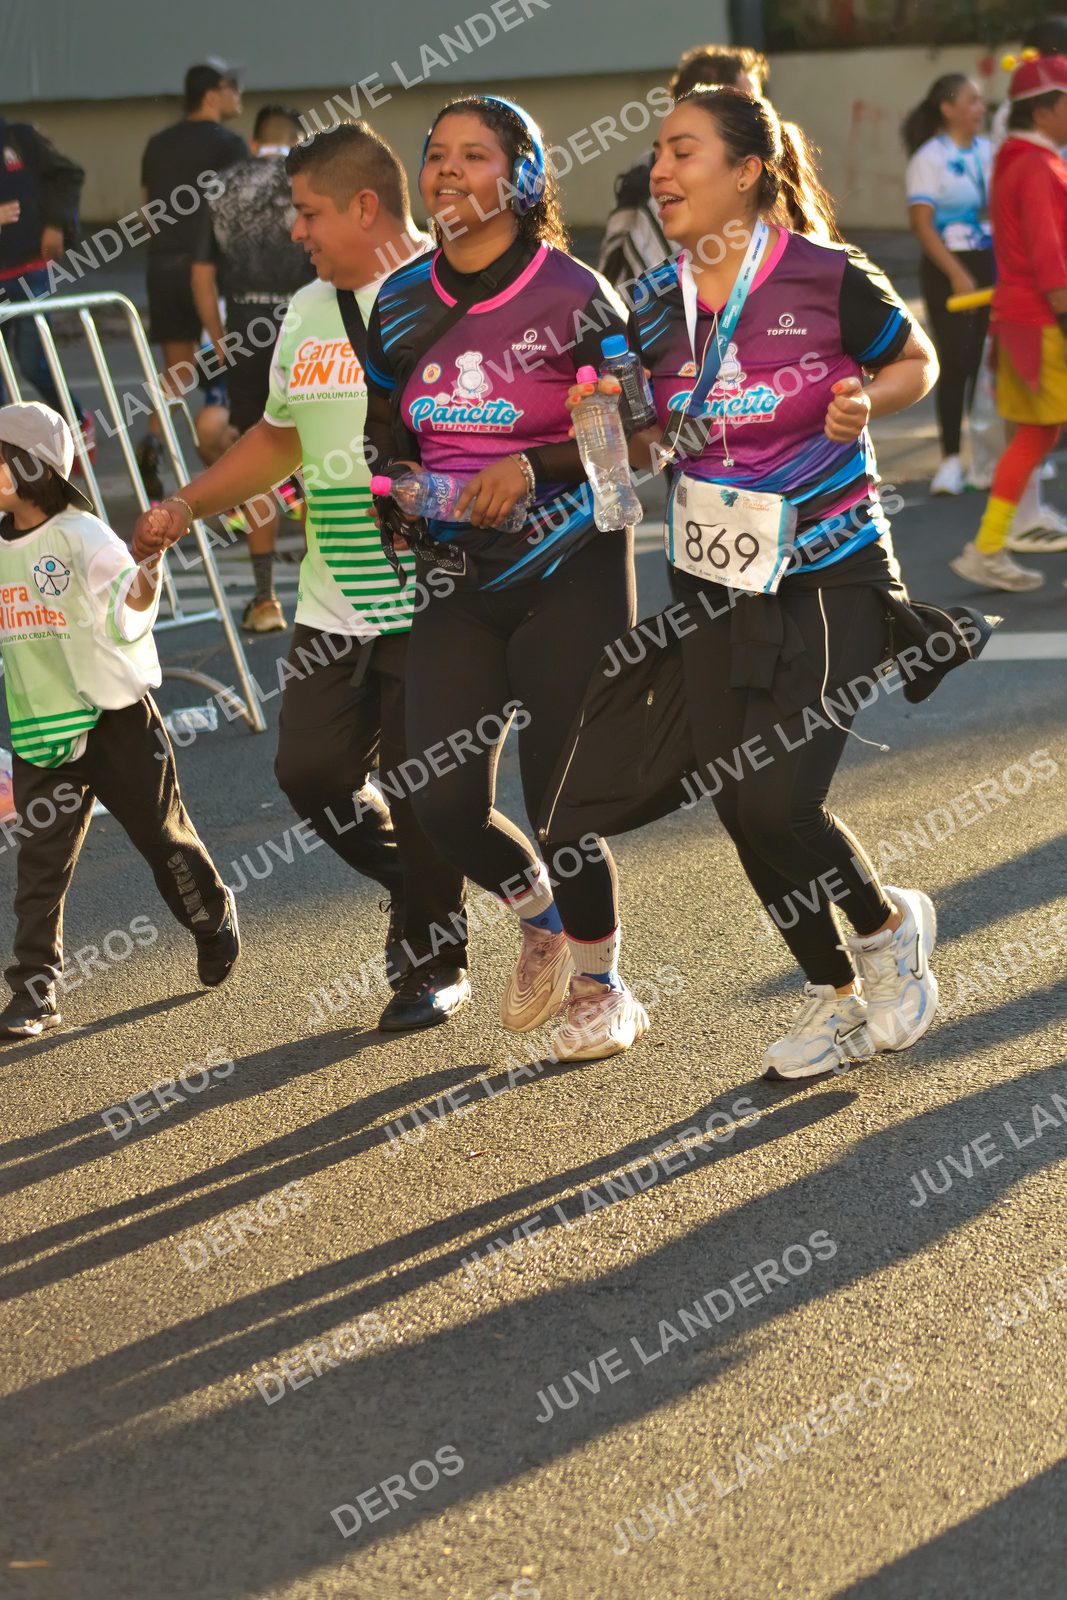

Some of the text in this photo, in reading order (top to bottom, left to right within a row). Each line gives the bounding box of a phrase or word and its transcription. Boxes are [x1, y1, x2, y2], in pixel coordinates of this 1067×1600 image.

[766, 328, 807, 336] TOPTIME
[298, 340, 355, 363] Carre
[511, 343, 547, 352] TOPTIME
[290, 360, 335, 388] SIN
[316, 390, 360, 400] VOLUNTAD
[409, 396, 524, 432] Pancito
[432, 422, 514, 433] RUNNERS
[685, 520, 760, 574] 869
[0, 586, 29, 604] era
[28, 630, 53, 640] CRUZA
